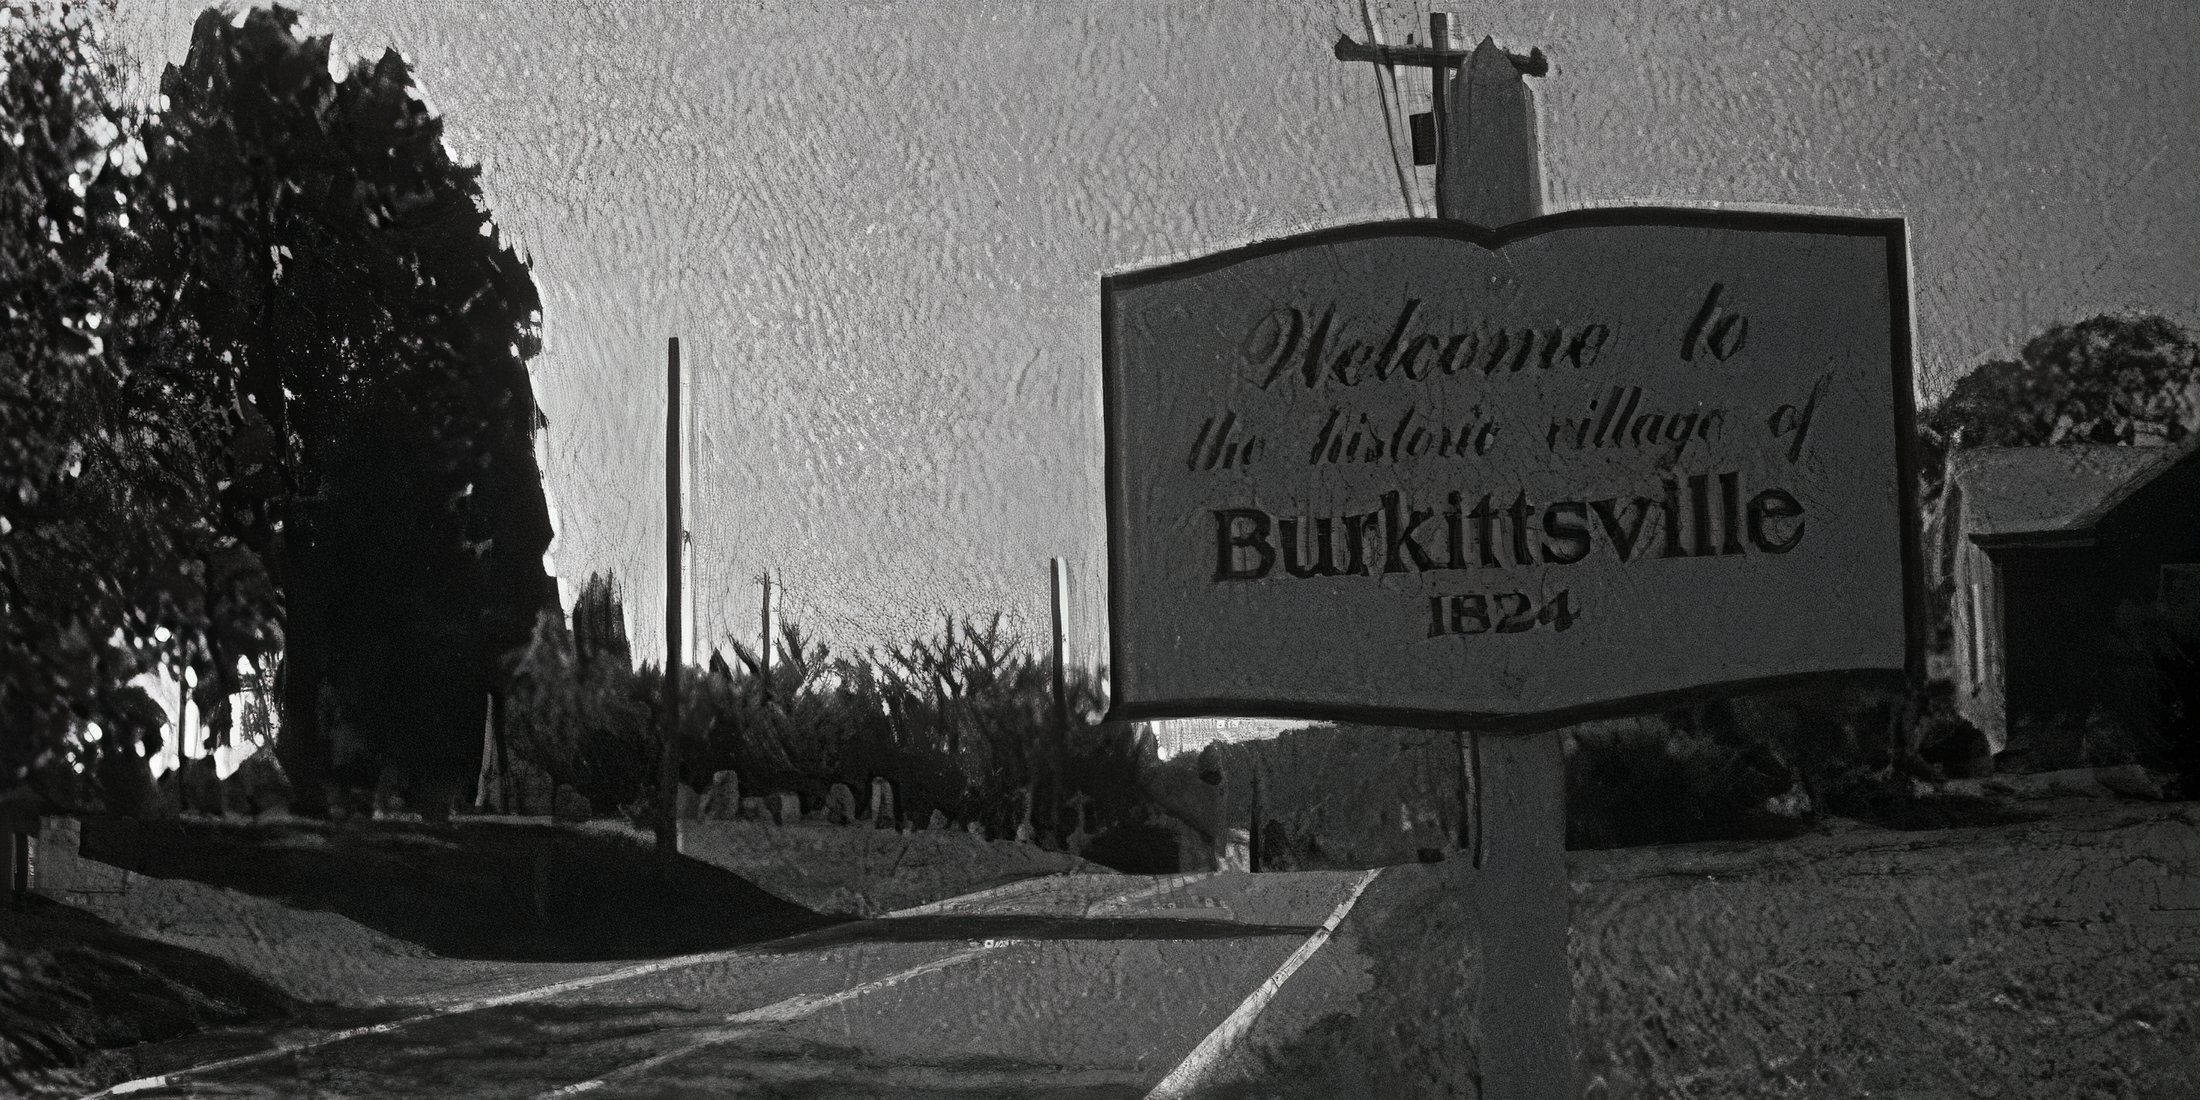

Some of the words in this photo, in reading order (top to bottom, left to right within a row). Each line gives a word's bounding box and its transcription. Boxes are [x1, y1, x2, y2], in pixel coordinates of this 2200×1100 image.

[1240, 299, 1608, 389] Welcome
[1679, 283, 1749, 361] to
[1187, 408, 1266, 471] the
[1308, 403, 1501, 465] historic
[1545, 386, 1726, 470] village
[1767, 365, 1829, 463] of
[1212, 472, 1806, 582] Burkittsville
[1427, 589, 1581, 638] 1824
